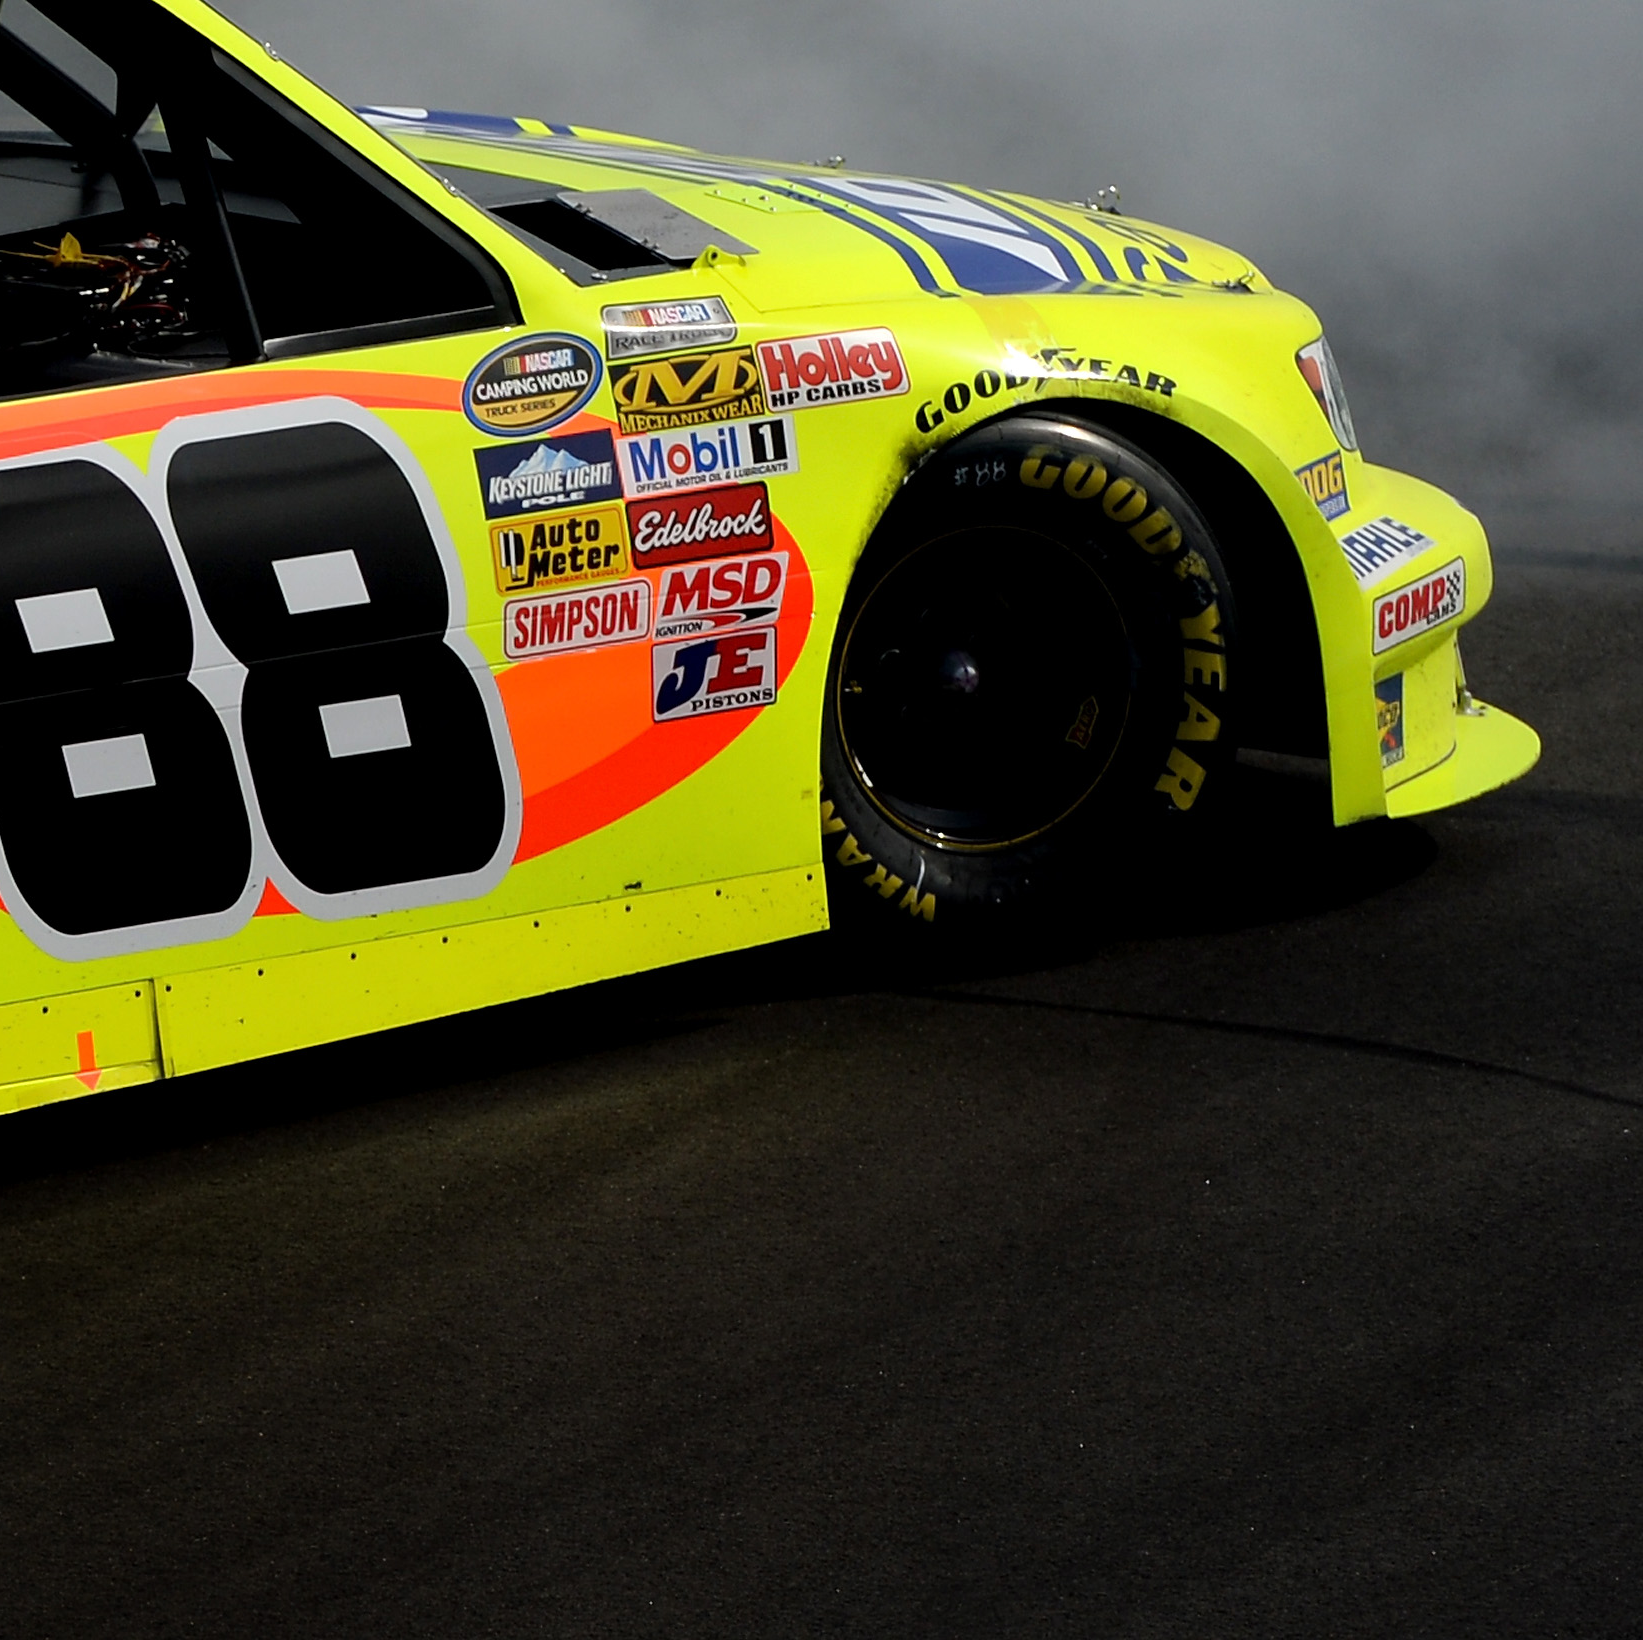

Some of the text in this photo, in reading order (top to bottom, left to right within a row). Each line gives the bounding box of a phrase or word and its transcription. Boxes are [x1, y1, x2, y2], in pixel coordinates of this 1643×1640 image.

[649, 303, 707, 325] NASCAR
[525, 348, 575, 372] NASCAR
[757, 335, 904, 391] Holley
[476, 368, 588, 401] CAMPING WORLD
[771, 378, 881, 408] HP CARBS
[485, 398, 556, 418] TRUCK SERIES
[619, 396, 763, 434] MECHANIX WEAR
[628, 423, 776, 482] Mobil 1
[489, 463, 609, 504] KEYSTONE LIGHT
[636, 462, 789, 494] OFFICIAL MOTOR OIL & LUBRICANTS
[522, 491, 585, 508] POLE
[530, 518, 599, 551] Auto
[634, 499, 766, 552] Edelbrock
[528, 542, 620, 578] Meter
[536, 572, 588, 588] PERFORMANCE
[662, 558, 782, 616] MSD
[515, 590, 639, 649] SIMPSON
[1379, 577, 1445, 639] COMP
[1426, 602, 1456, 625] CAMS
[655, 621, 703, 638] IGNITION
[656, 633, 767, 715] JE
[690, 688, 773, 712] PISTONS
